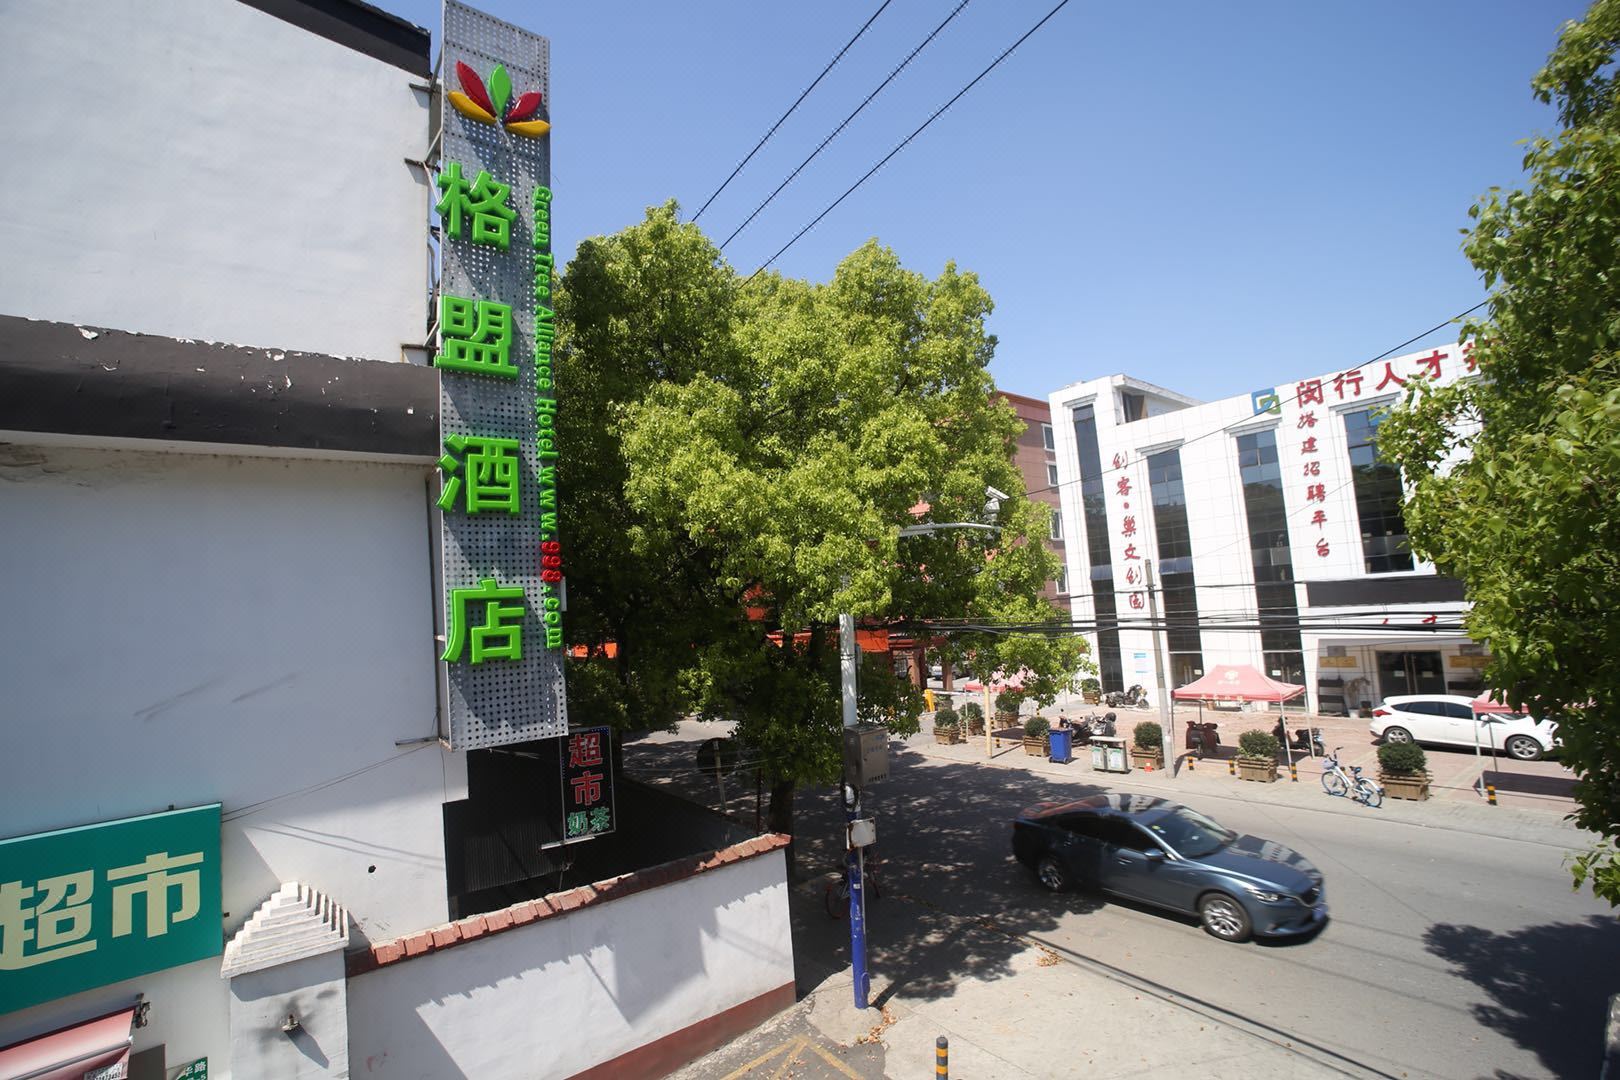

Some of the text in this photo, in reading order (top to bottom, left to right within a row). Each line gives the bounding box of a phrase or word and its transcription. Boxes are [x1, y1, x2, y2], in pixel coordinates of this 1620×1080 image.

[533, 186, 553, 249] Green
[534, 252, 555, 297] Tree
[535, 304, 557, 390] Alliance
[434, 162, 526, 664] 格盟酒店
[536, 397, 560, 459] Hotel
[568, 733, 604, 806] 超市
[567, 806, 611, 837] 奶茶
[0, 851, 204, 970] 超市
